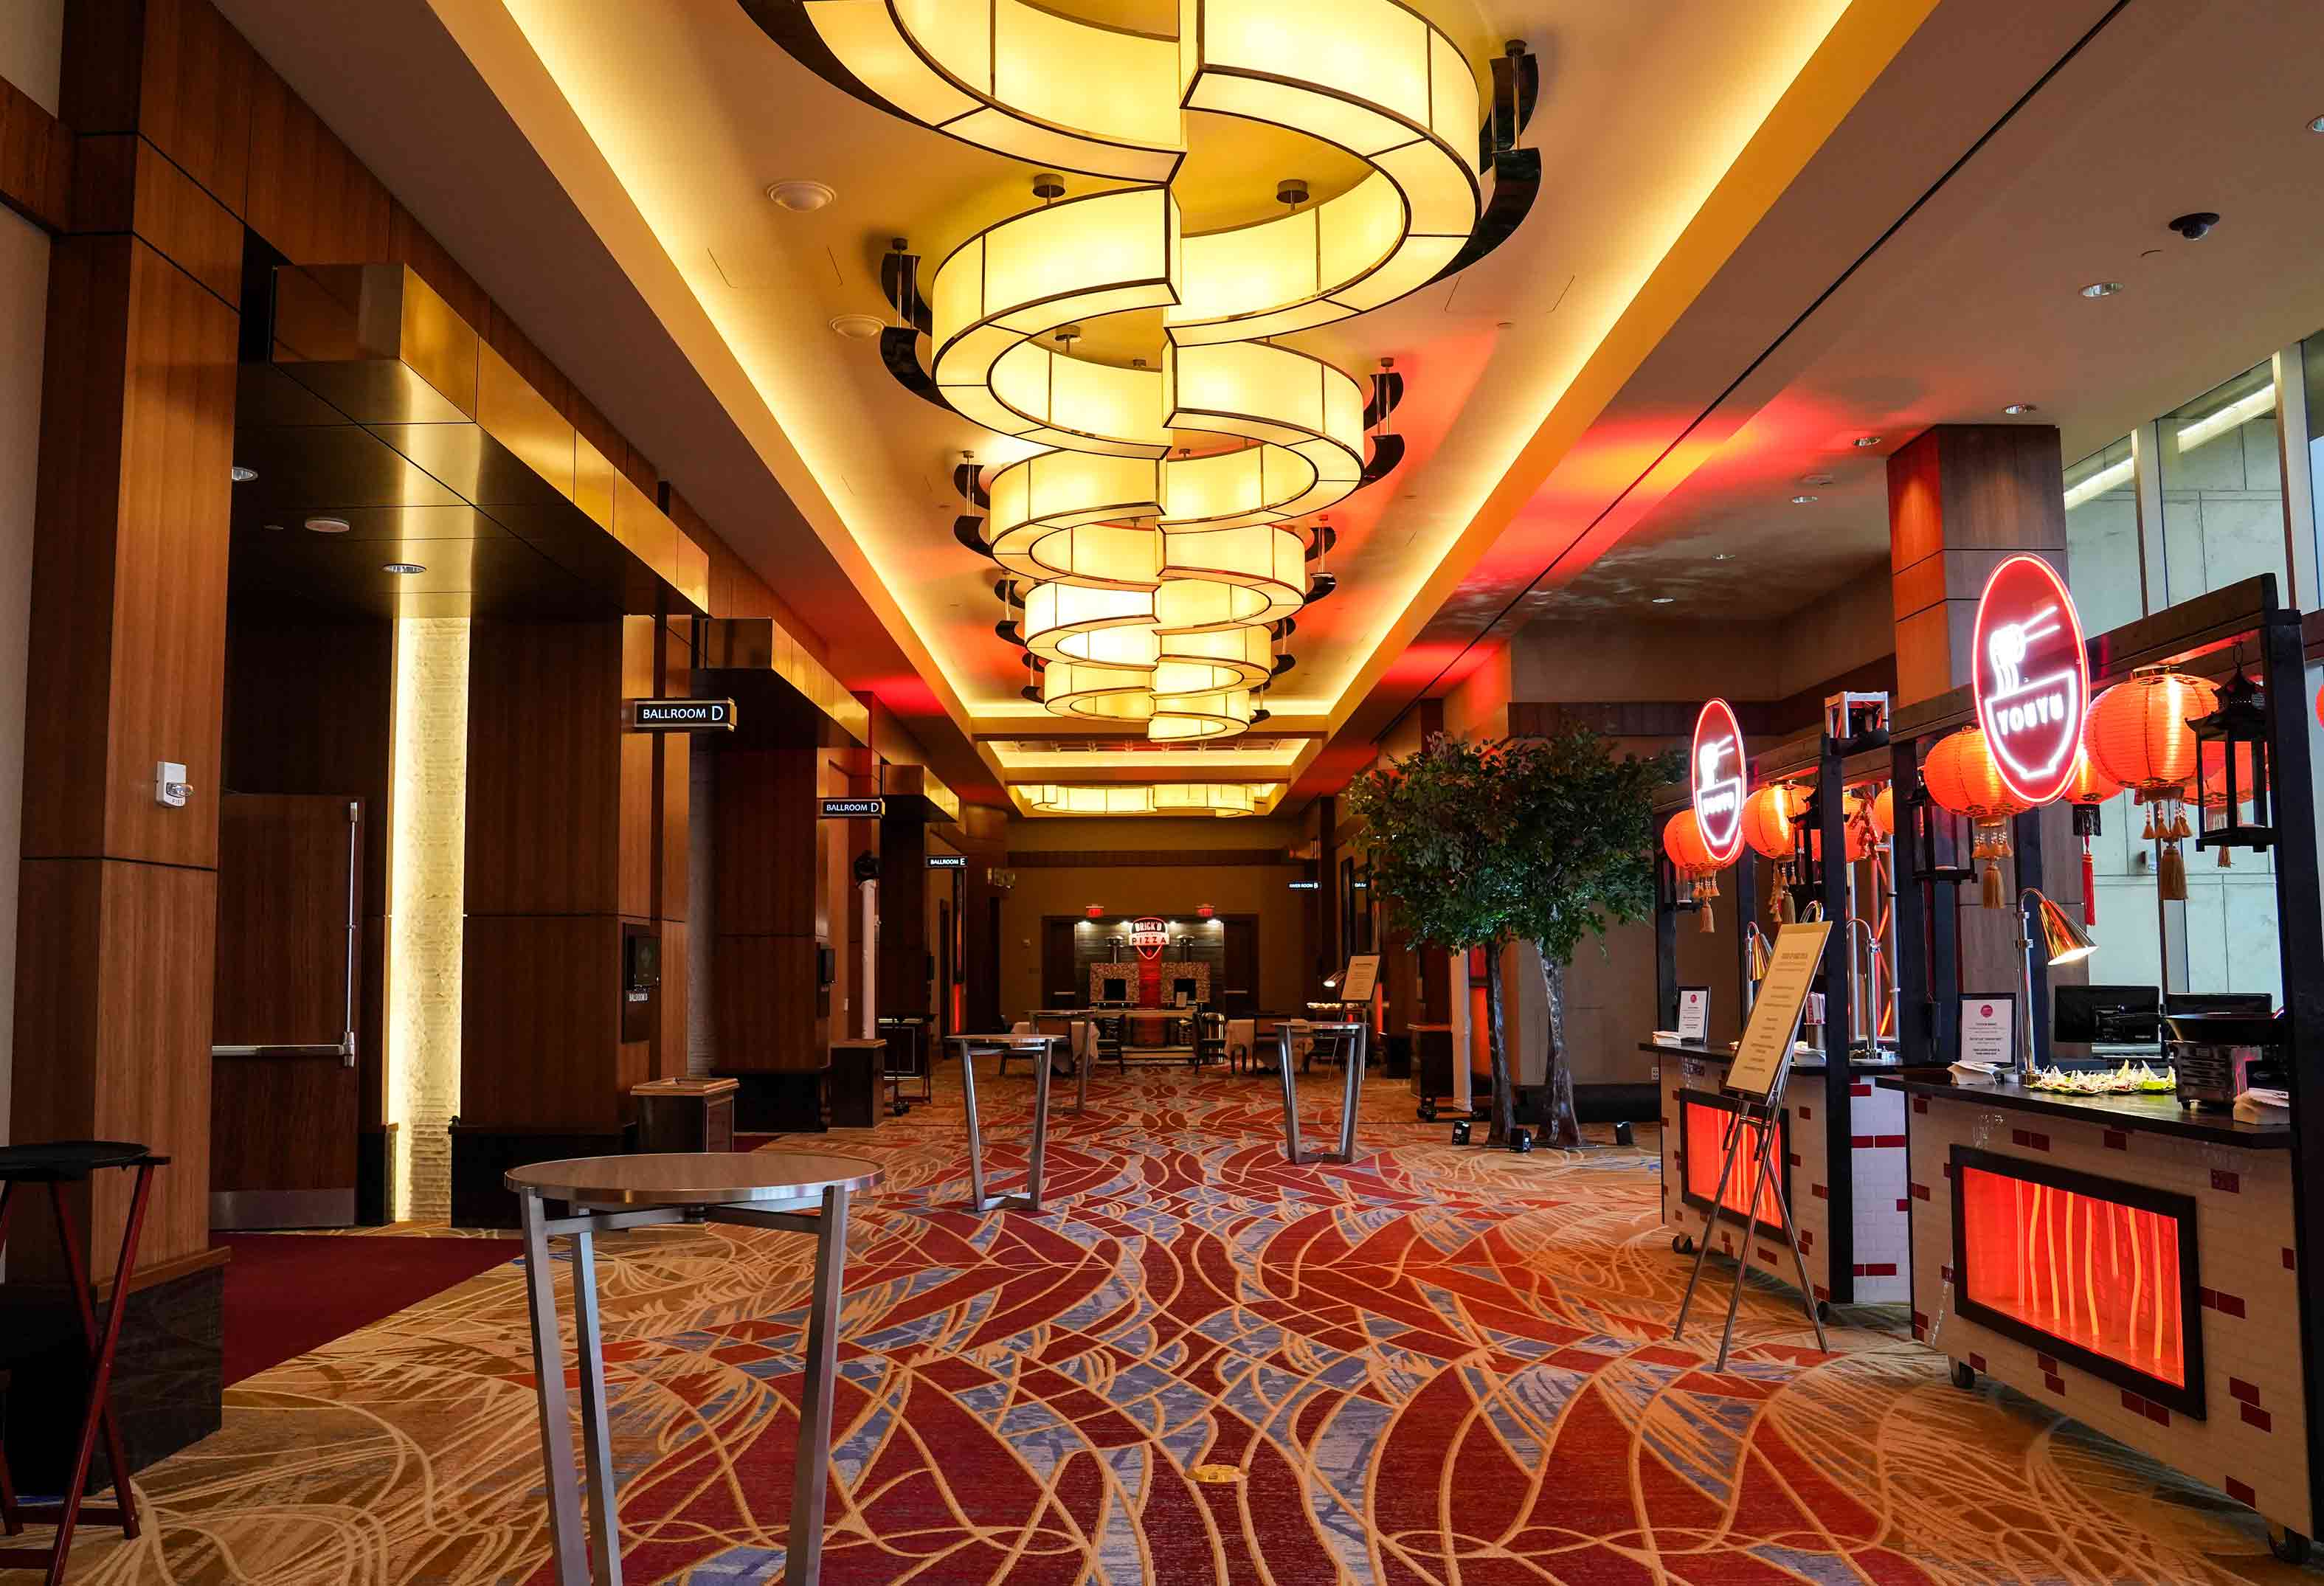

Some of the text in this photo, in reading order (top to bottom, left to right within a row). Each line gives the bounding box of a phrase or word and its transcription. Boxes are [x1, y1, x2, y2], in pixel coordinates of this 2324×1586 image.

[643, 705, 723, 721] BALLROOM D
[1996, 693, 2064, 735] YOUYU
[826, 803, 879, 812] BALLROOM D
[1132, 936, 1166, 945] PIZZA
